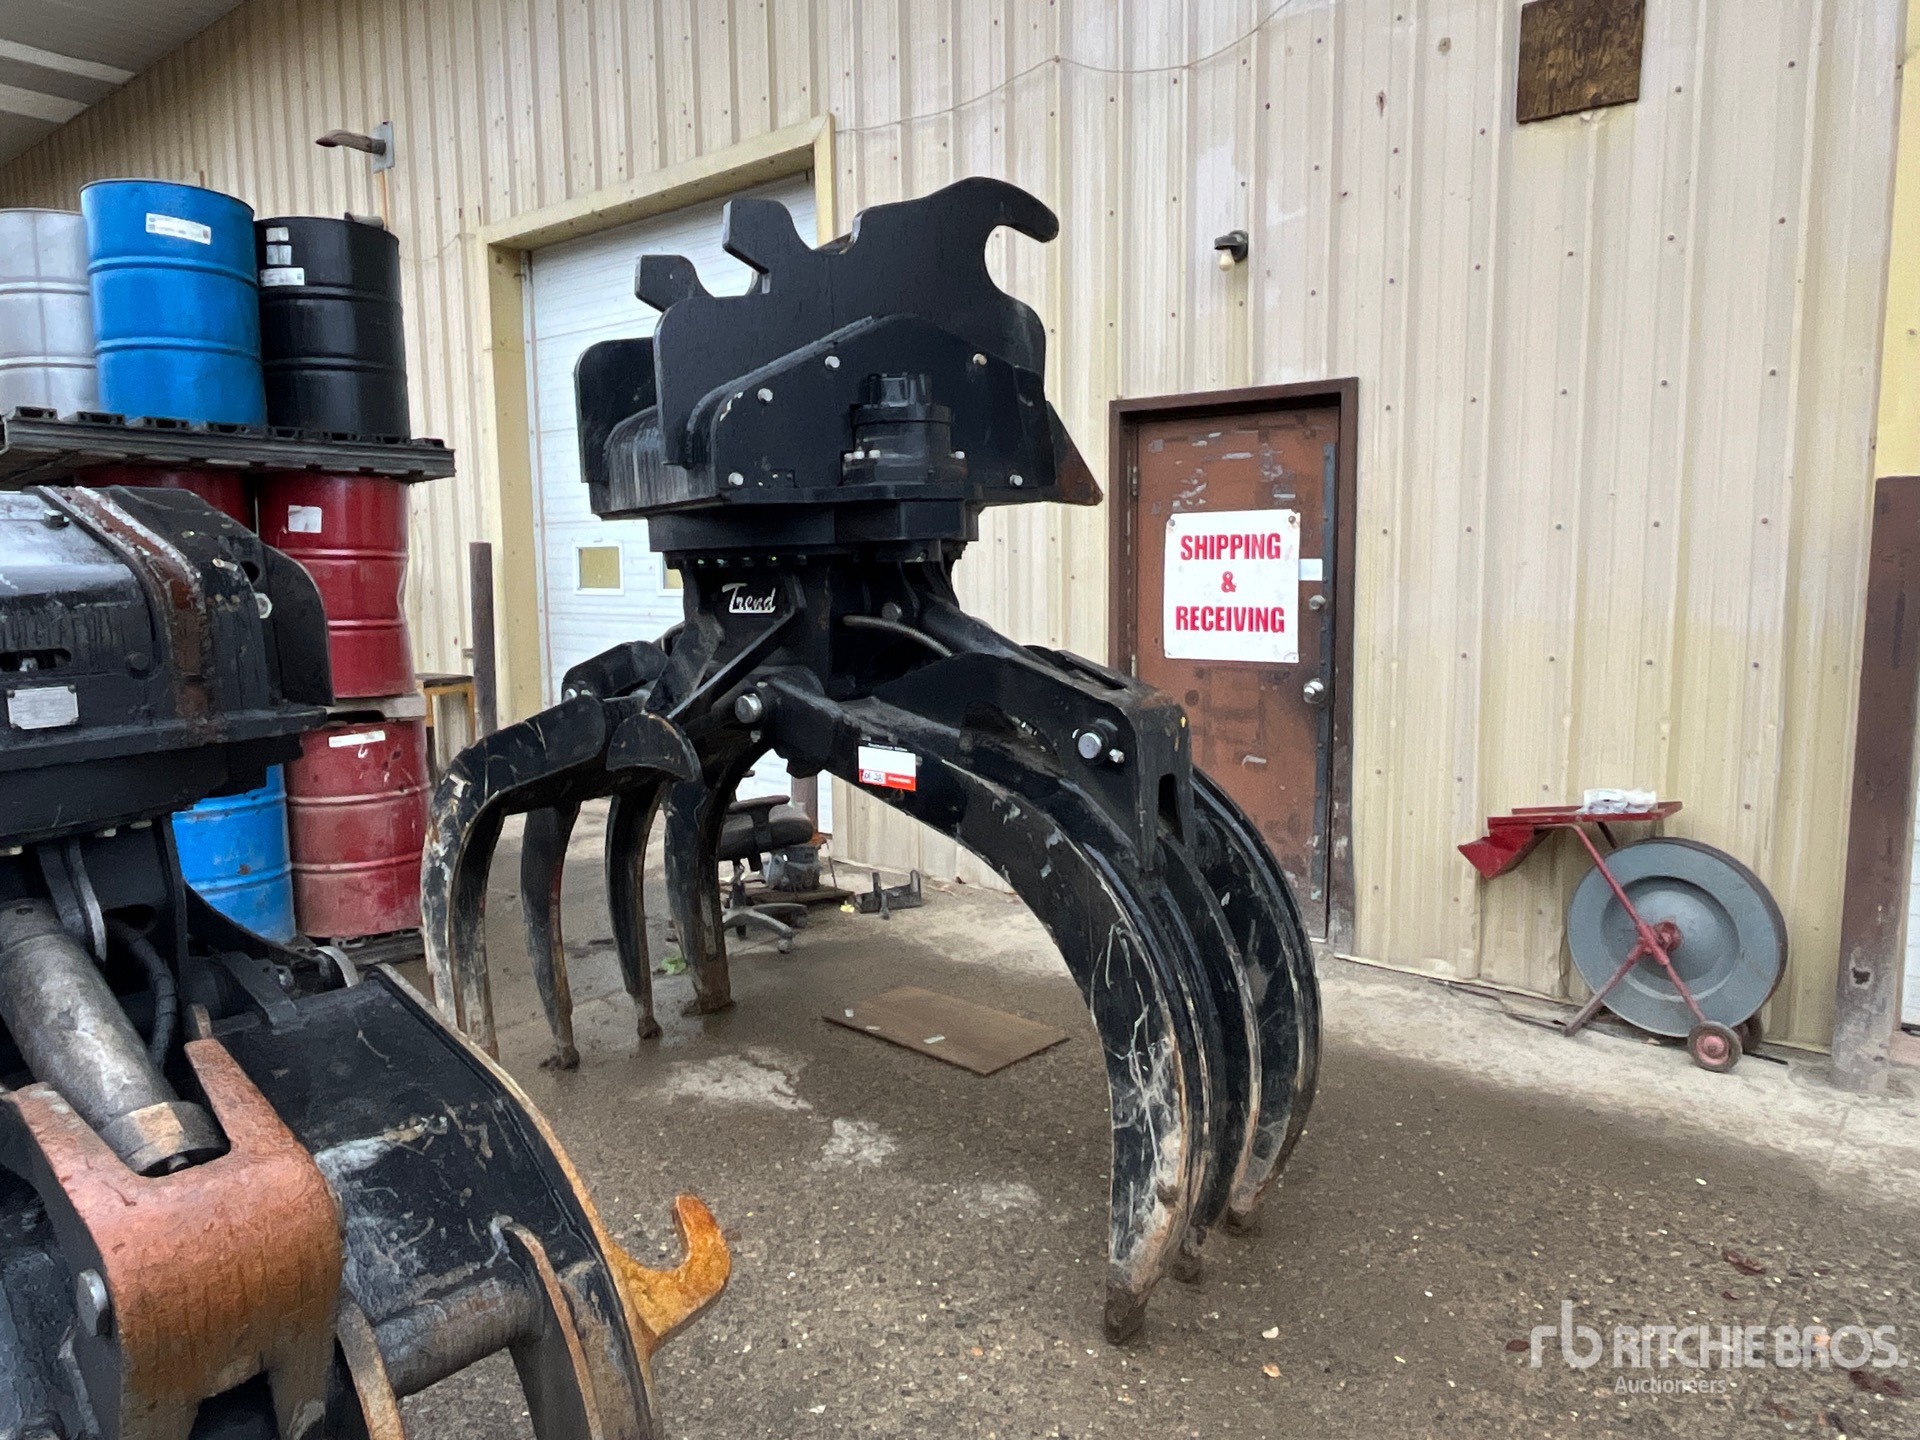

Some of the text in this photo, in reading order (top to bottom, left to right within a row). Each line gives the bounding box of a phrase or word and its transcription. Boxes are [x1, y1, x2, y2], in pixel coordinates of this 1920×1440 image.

[1180, 533, 1281, 561] SHIPPING
[1221, 571, 1237, 593] &
[721, 583, 776, 614] Trend
[1175, 605, 1285, 633] RECEIVING
